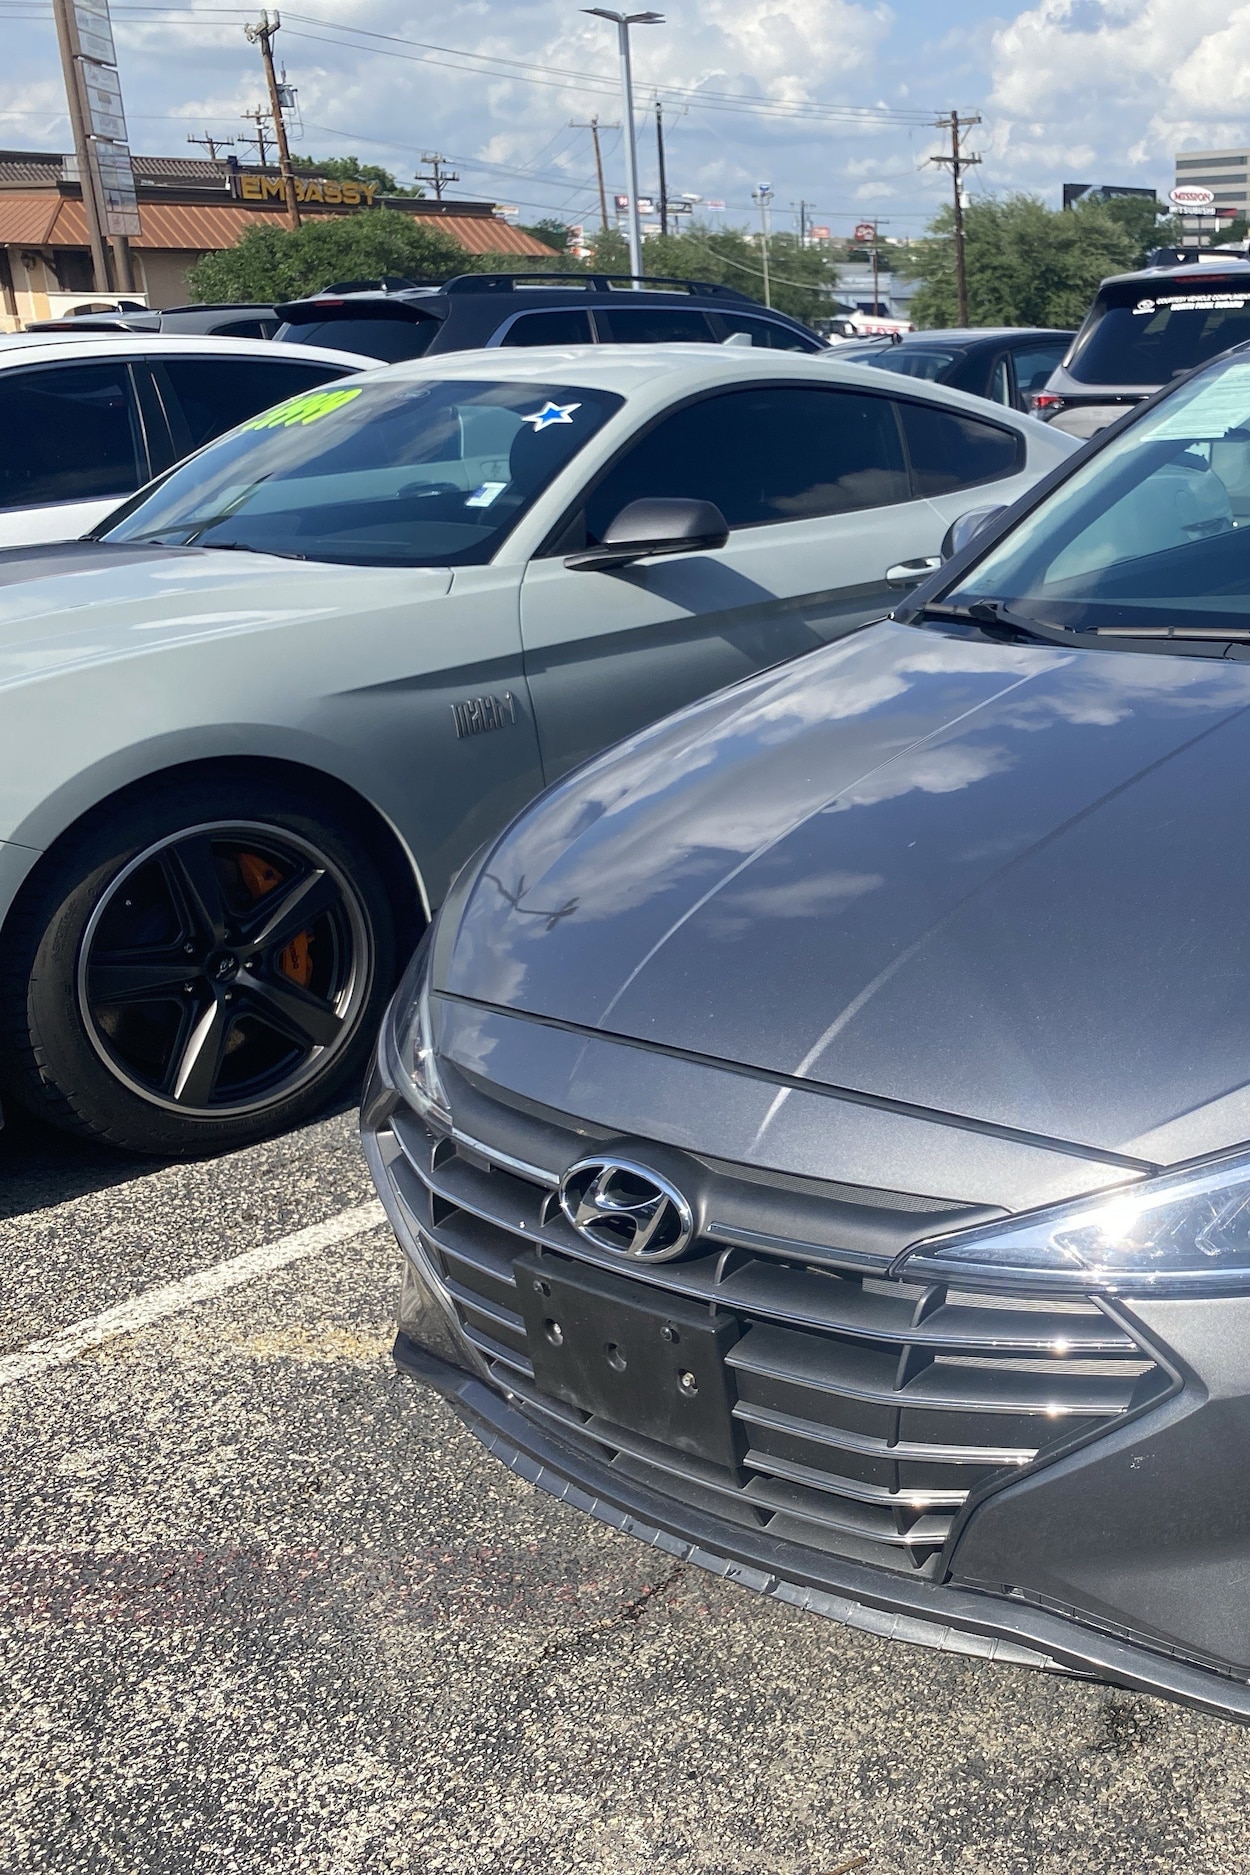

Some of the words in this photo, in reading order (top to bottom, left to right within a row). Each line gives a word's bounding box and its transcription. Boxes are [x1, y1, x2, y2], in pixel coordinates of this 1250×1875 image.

[1174, 191, 1211, 201] MISSION
[450, 695, 505, 739] MACH
[506, 690, 517, 726] 1
